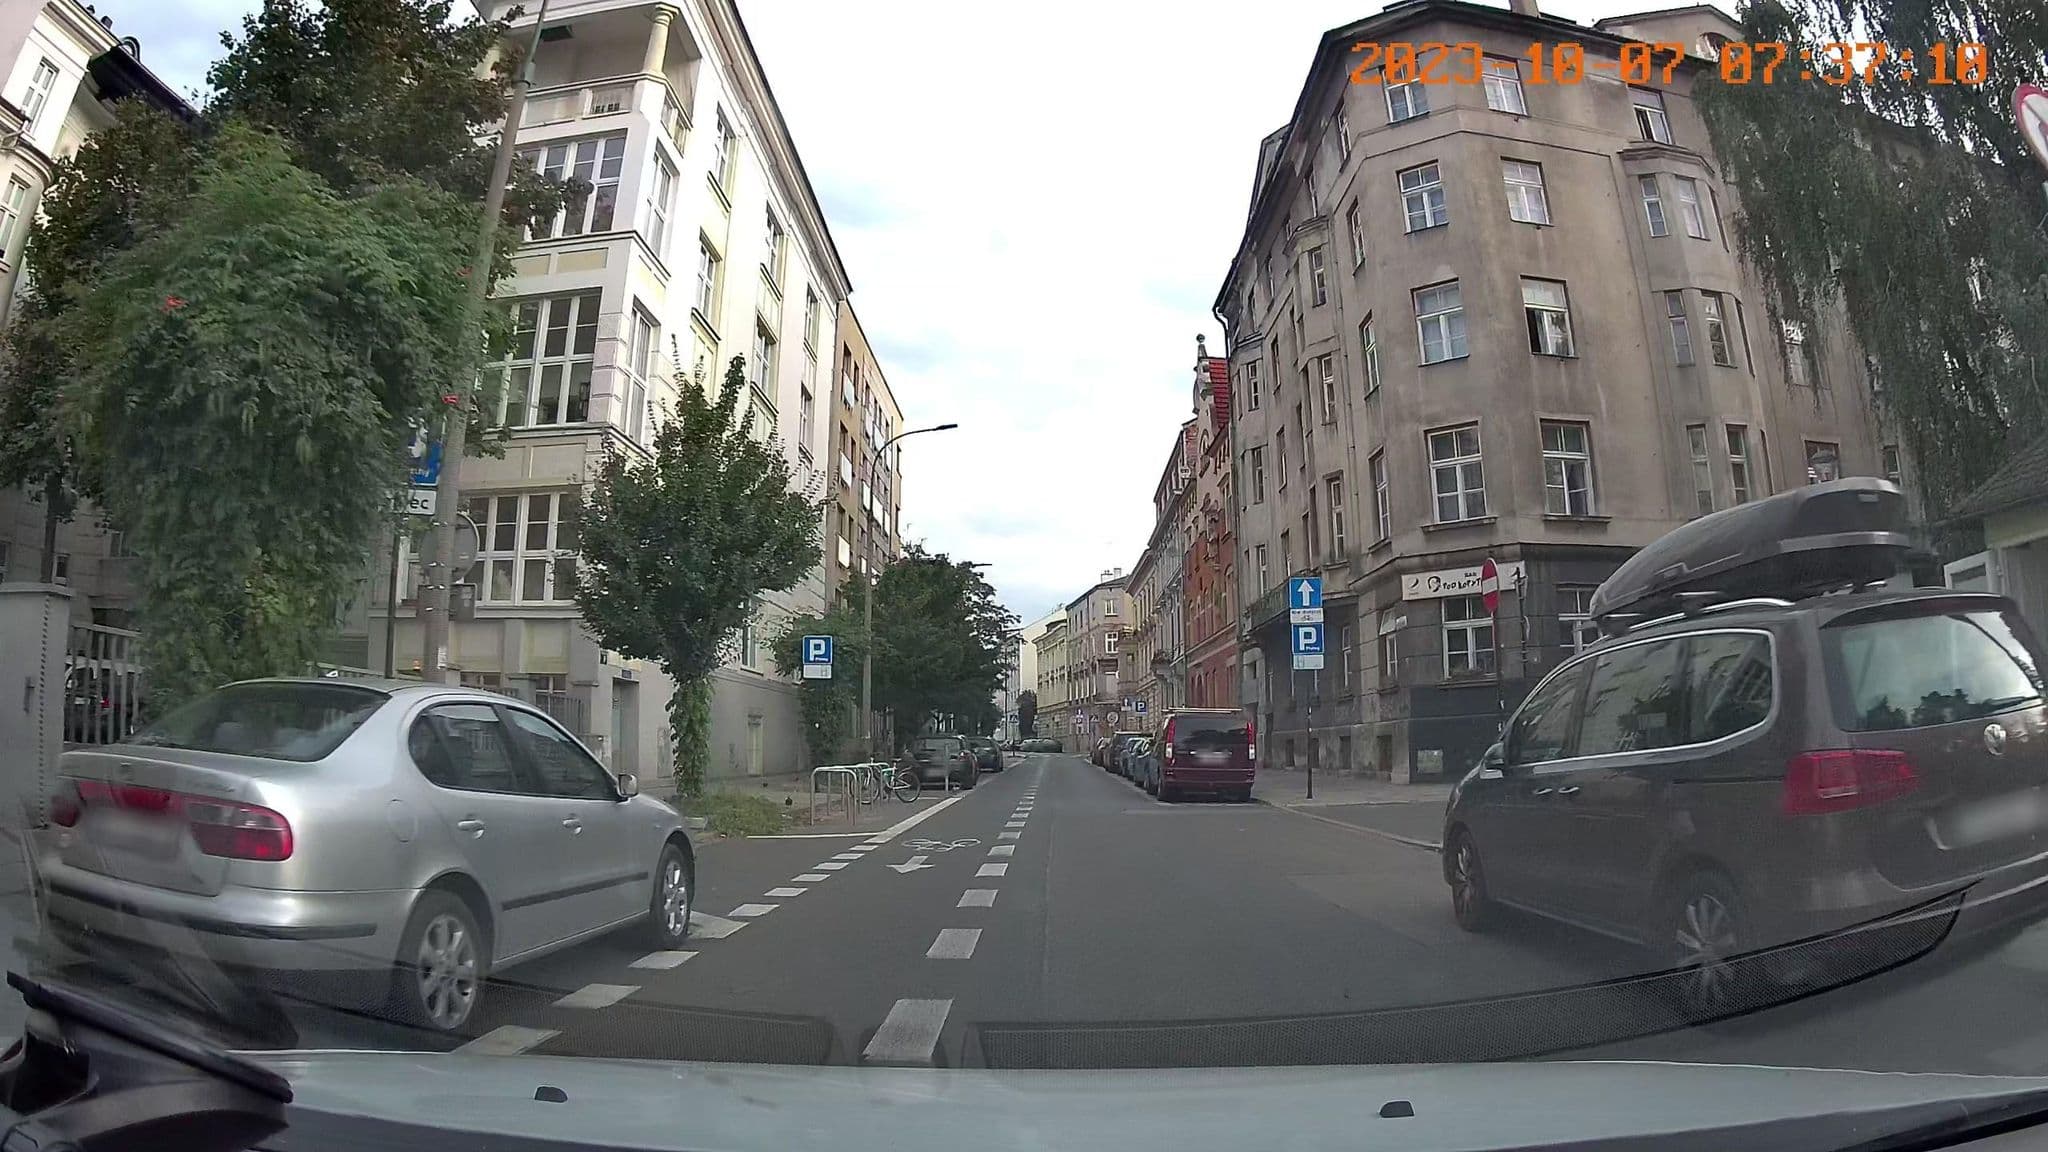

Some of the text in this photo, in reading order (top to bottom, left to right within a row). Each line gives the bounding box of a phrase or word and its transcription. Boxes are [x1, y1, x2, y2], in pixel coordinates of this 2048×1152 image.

[1458, 577, 1481, 589] KOPYT
[809, 639, 826, 661] P
[1299, 627, 1317, 651] P
